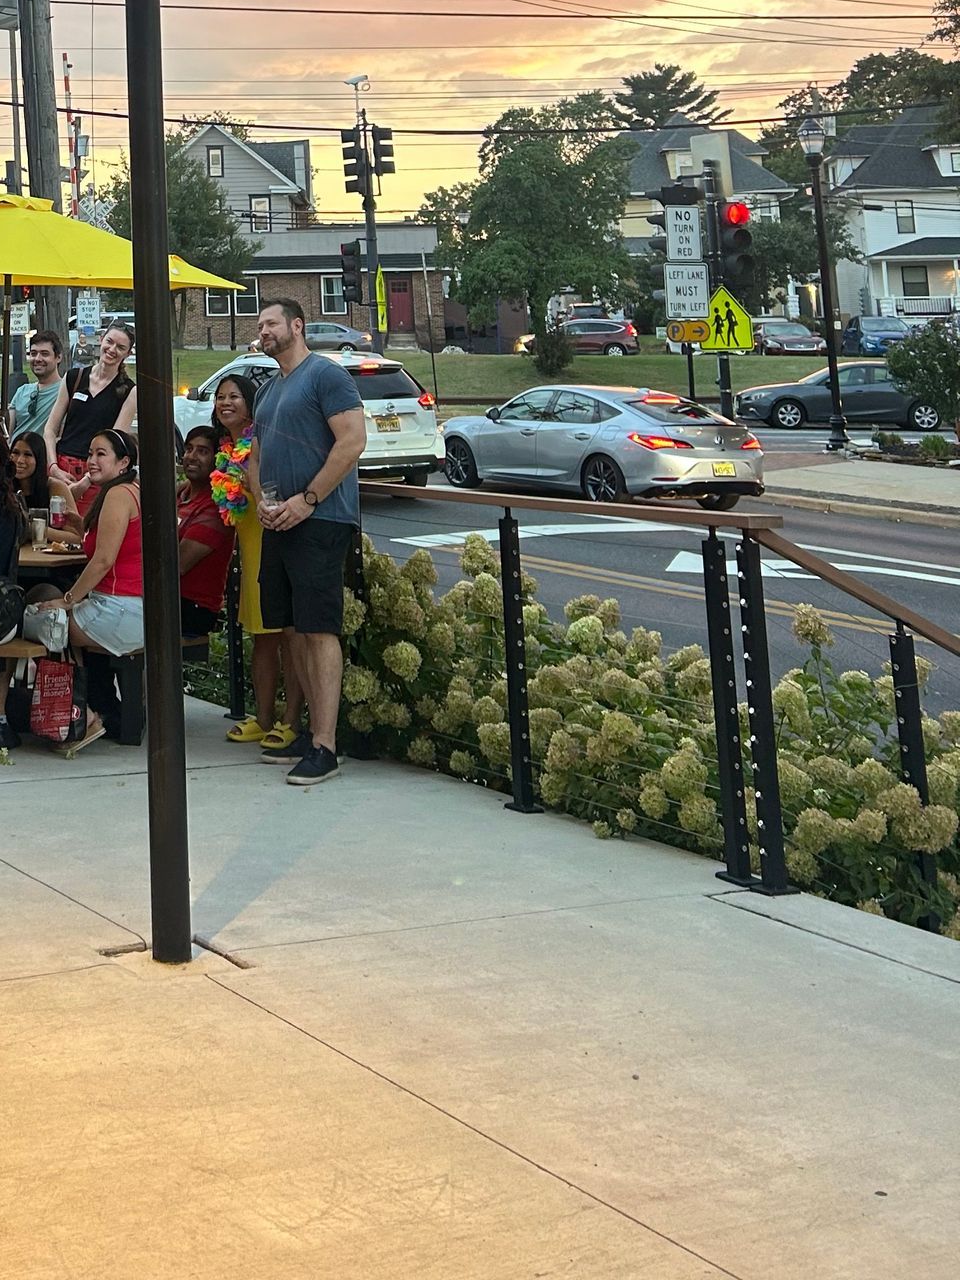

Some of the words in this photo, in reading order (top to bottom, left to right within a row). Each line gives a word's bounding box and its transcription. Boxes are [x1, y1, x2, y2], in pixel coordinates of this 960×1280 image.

[80, 199, 95, 217] RAIL
[675, 210, 691, 221] NO
[673, 223, 694, 233] TURN
[678, 235, 690, 245] ON
[677, 247, 693, 257] RED
[668, 270, 684, 280] LEFT
[687, 270, 704, 280] LANE
[675, 285, 698, 297] MUST
[670, 302, 687, 312] TURN
[690, 302, 706, 312] LEFT
[671, 325, 680, 339] P
